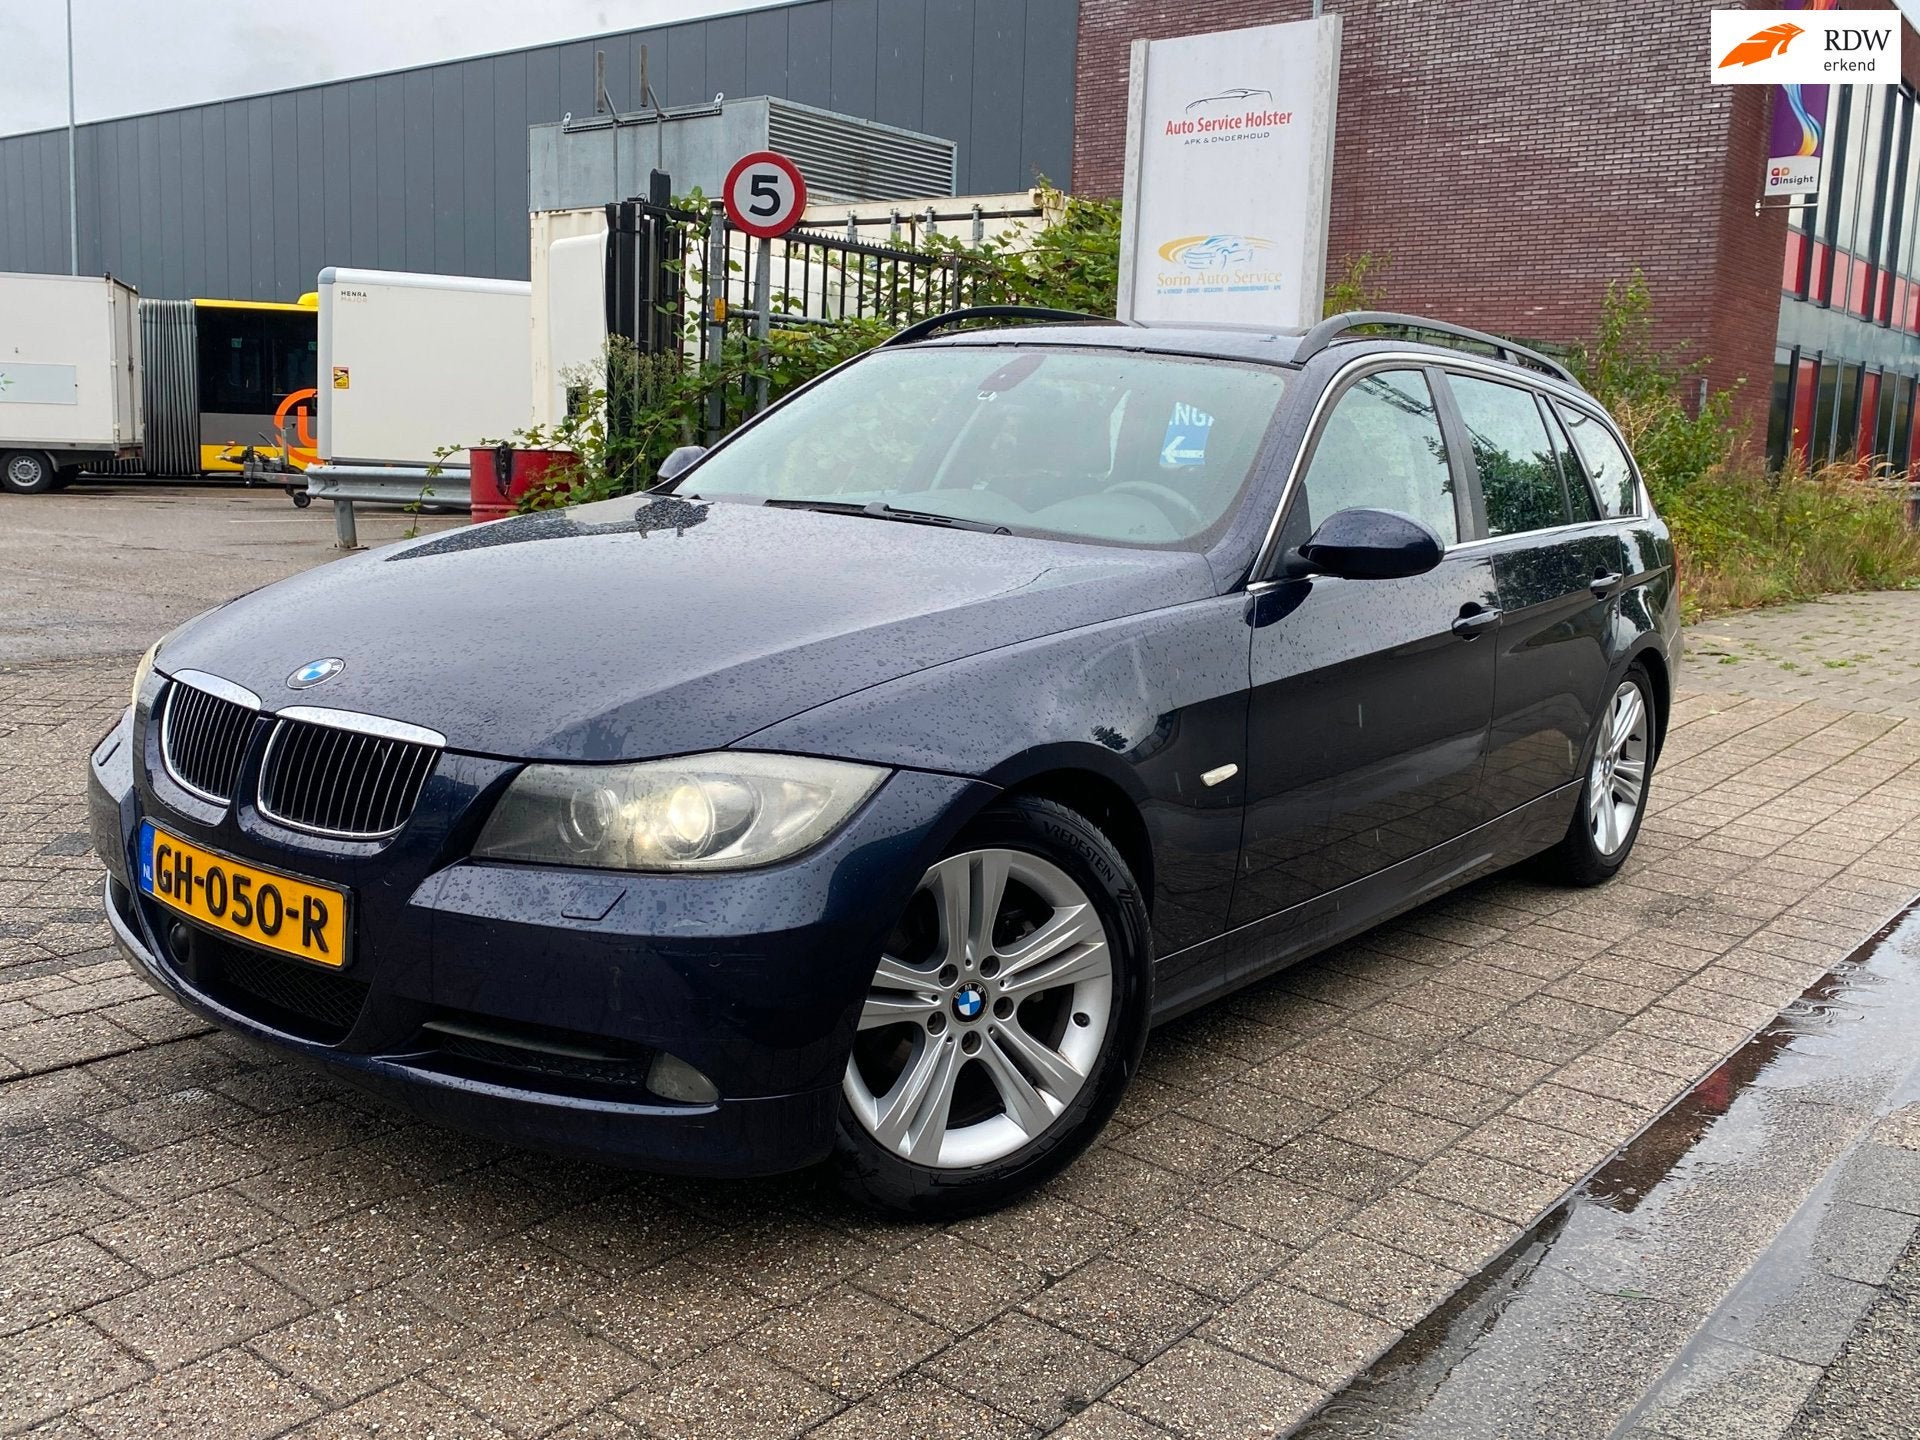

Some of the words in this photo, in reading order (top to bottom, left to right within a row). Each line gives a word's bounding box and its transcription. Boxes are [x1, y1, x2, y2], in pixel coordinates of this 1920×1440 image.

[1165, 120, 1195, 136] Auto
[1197, 115, 1242, 132] Service
[1245, 110, 1293, 129] Holster
[1184, 138, 1202, 146] APK
[1211, 132, 1270, 143] ONDERHOUD
[1779, 175, 1815, 186] Insight
[749, 174, 781, 217] 5
[1157, 271, 1191, 287] Sorin
[1196, 271, 1229, 285] Auto
[1233, 268, 1282, 284] Service
[340, 290, 368, 298] HENRA
[1043, 821, 1116, 882] VREDESTEIN
[142, 863, 153, 881] NL
[156, 844, 329, 952] GH-050-R
[954, 983, 984, 1000] BMW
